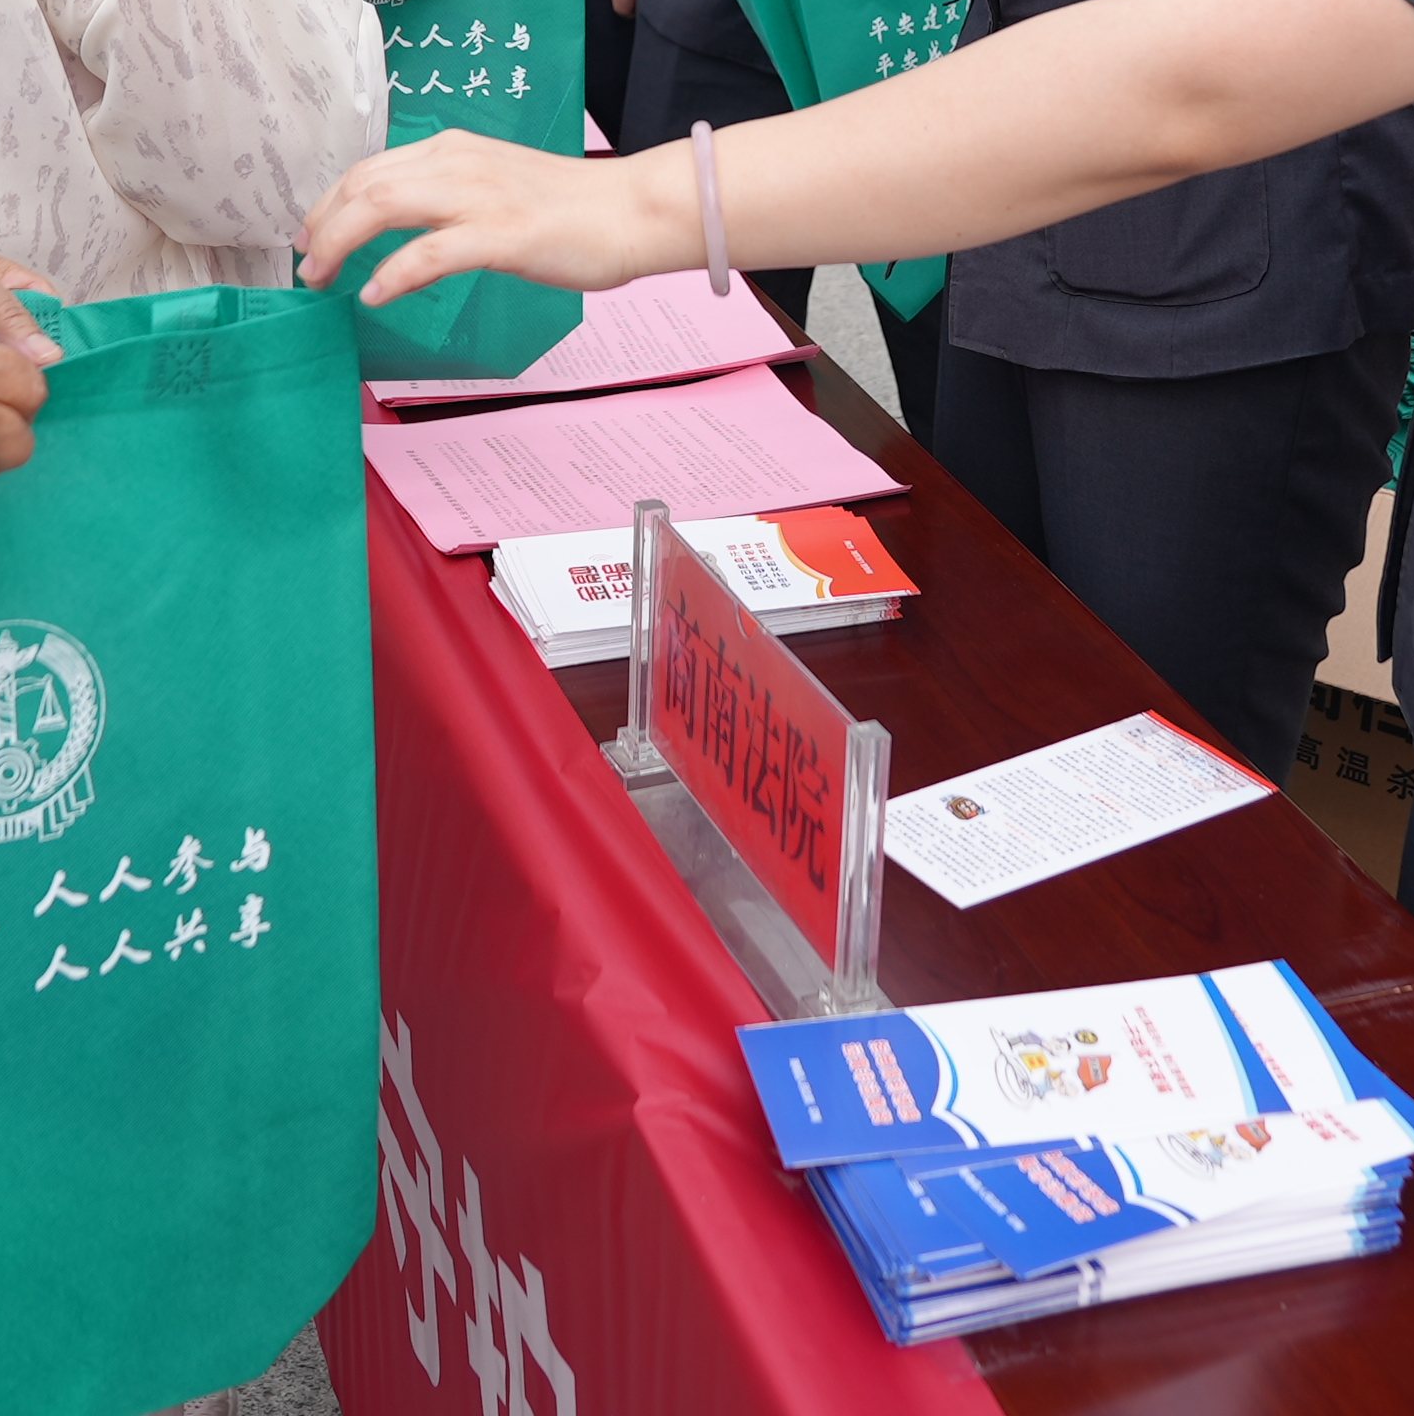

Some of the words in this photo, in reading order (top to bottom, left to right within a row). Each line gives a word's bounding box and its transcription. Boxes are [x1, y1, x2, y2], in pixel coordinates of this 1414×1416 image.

[384, 20, 531, 56] 人人参与
[387, 64, 532, 101] 人人共享
[665, 588, 833, 893] 商南法院
[33, 826, 272, 917] 人人参与
[34, 892, 273, 993] 人人共享
